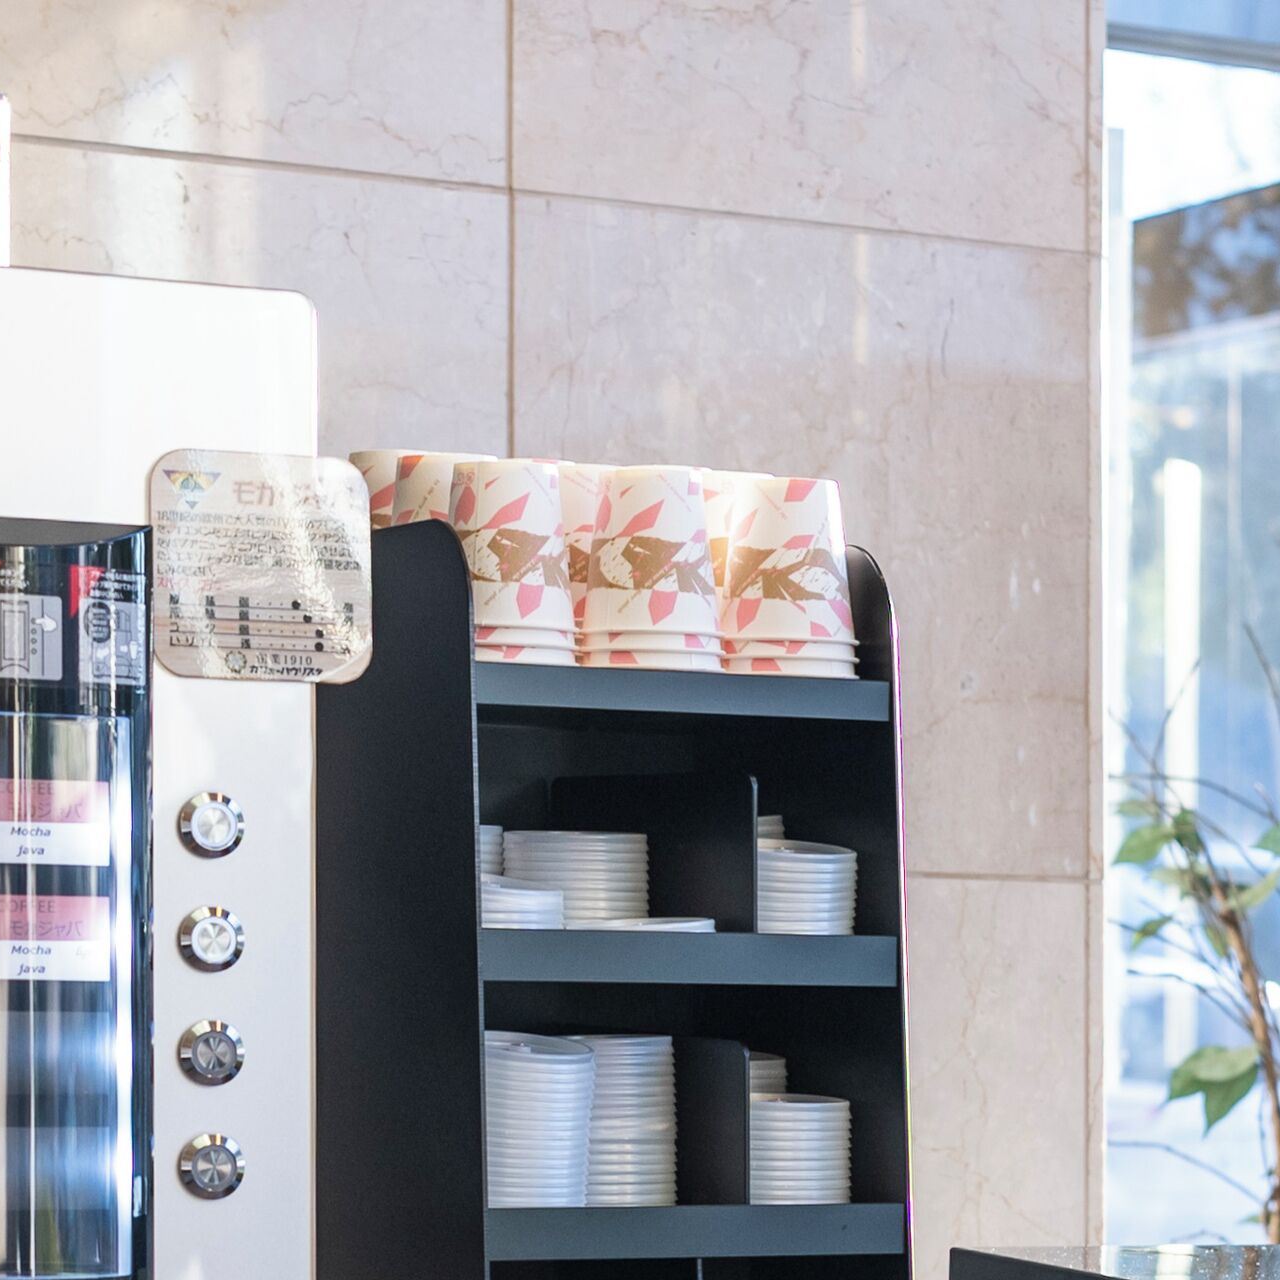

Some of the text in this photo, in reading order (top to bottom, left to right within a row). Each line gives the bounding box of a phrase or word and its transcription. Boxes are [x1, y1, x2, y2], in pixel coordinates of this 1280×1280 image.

[10, 827, 51, 837] Mocha
[17, 846, 45, 857] Java
[18, 963, 46, 976] Java
